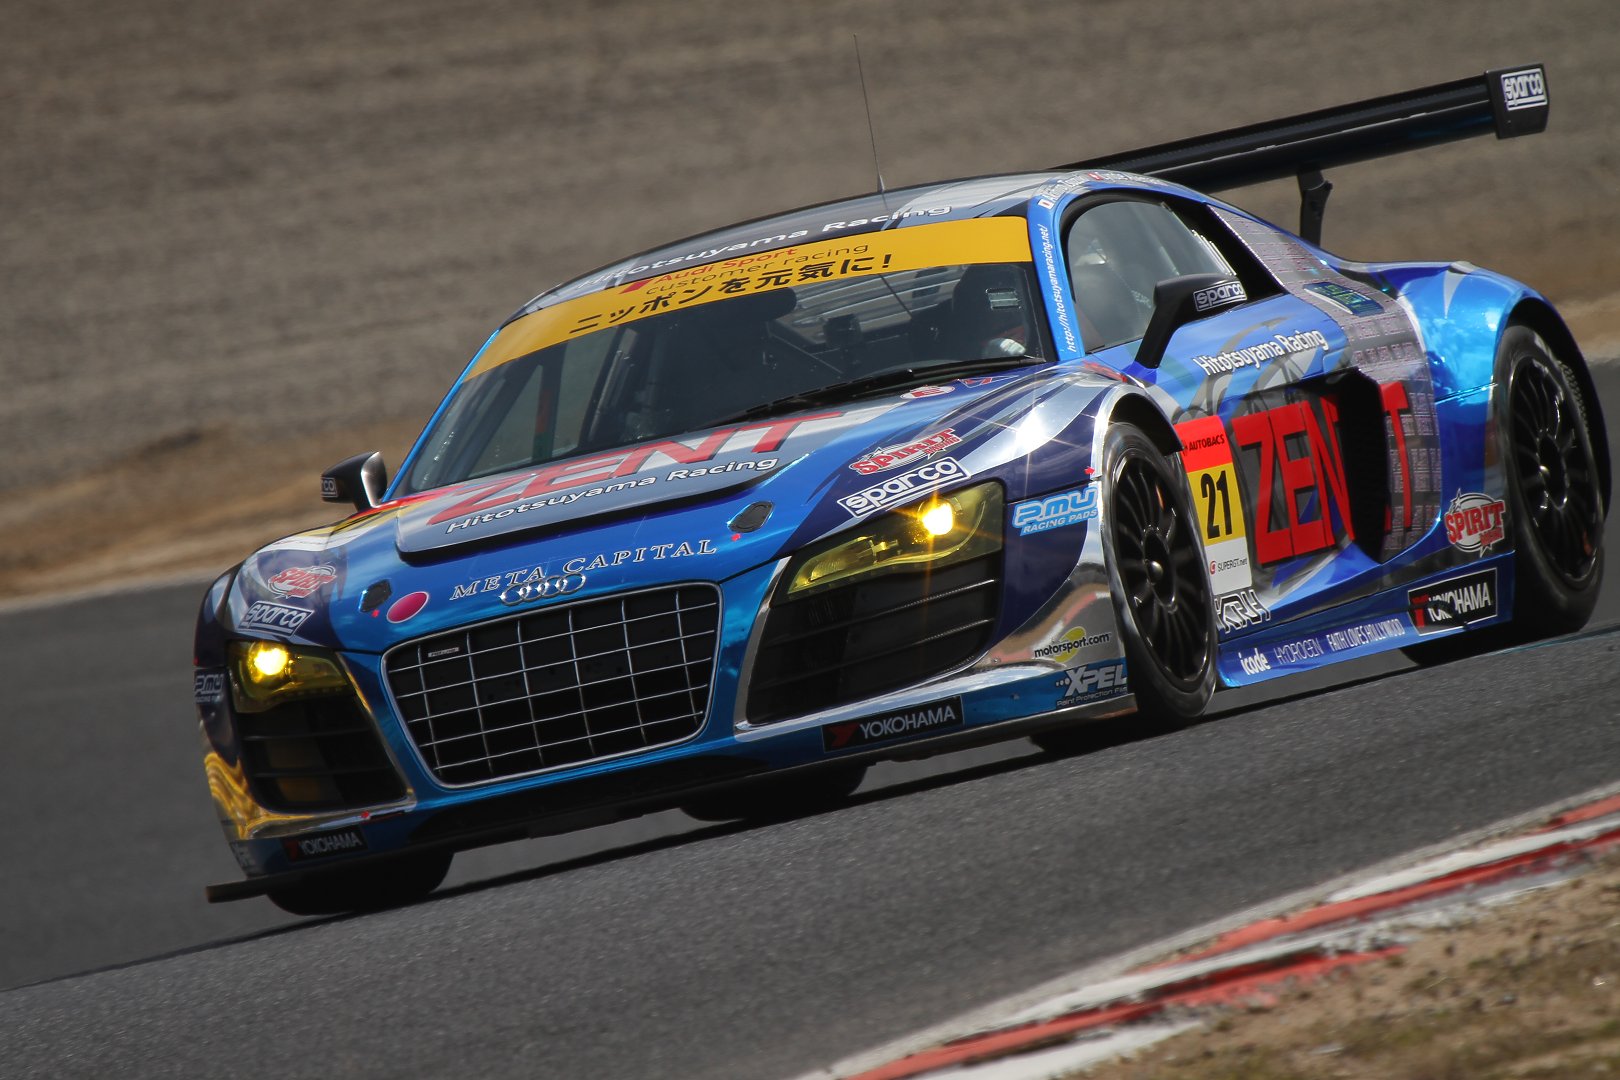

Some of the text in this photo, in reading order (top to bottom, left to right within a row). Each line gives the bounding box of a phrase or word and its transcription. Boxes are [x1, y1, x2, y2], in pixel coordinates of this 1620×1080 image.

[574, 205, 952, 290] Hitotsuyama Racing
[654, 248, 798, 284] Audi Sport
[645, 244, 869, 296] customer racing
[1037, 224, 1078, 353] http://hitotsuyamaracing.net/
[1196, 284, 1244, 309] sparco
[1193, 339, 1284, 377] Hitotsuyama
[1281, 328, 1330, 357] Racing
[850, 428, 956, 475] SPIRIT
[1188, 433, 1226, 452] AUTOBACS
[426, 410, 844, 526] ZENT
[845, 461, 960, 510] sparco
[445, 456, 779, 535] Hitotsuyama Racing
[1200, 469, 1233, 540] 21
[1022, 508, 1099, 534] RACING PADS
[1445, 501, 1505, 544] SPIRIT
[449, 539, 718, 600] META CAPITAL
[245, 603, 305, 630] sparco
[1034, 632, 1110, 658] motorsport.com
[1273, 638, 1324, 665] HYDROGEN
[1064, 664, 1127, 697] XPEL
[860, 704, 956, 739] YOKOHAMA
[299, 831, 363, 856] YOKOHAMA
